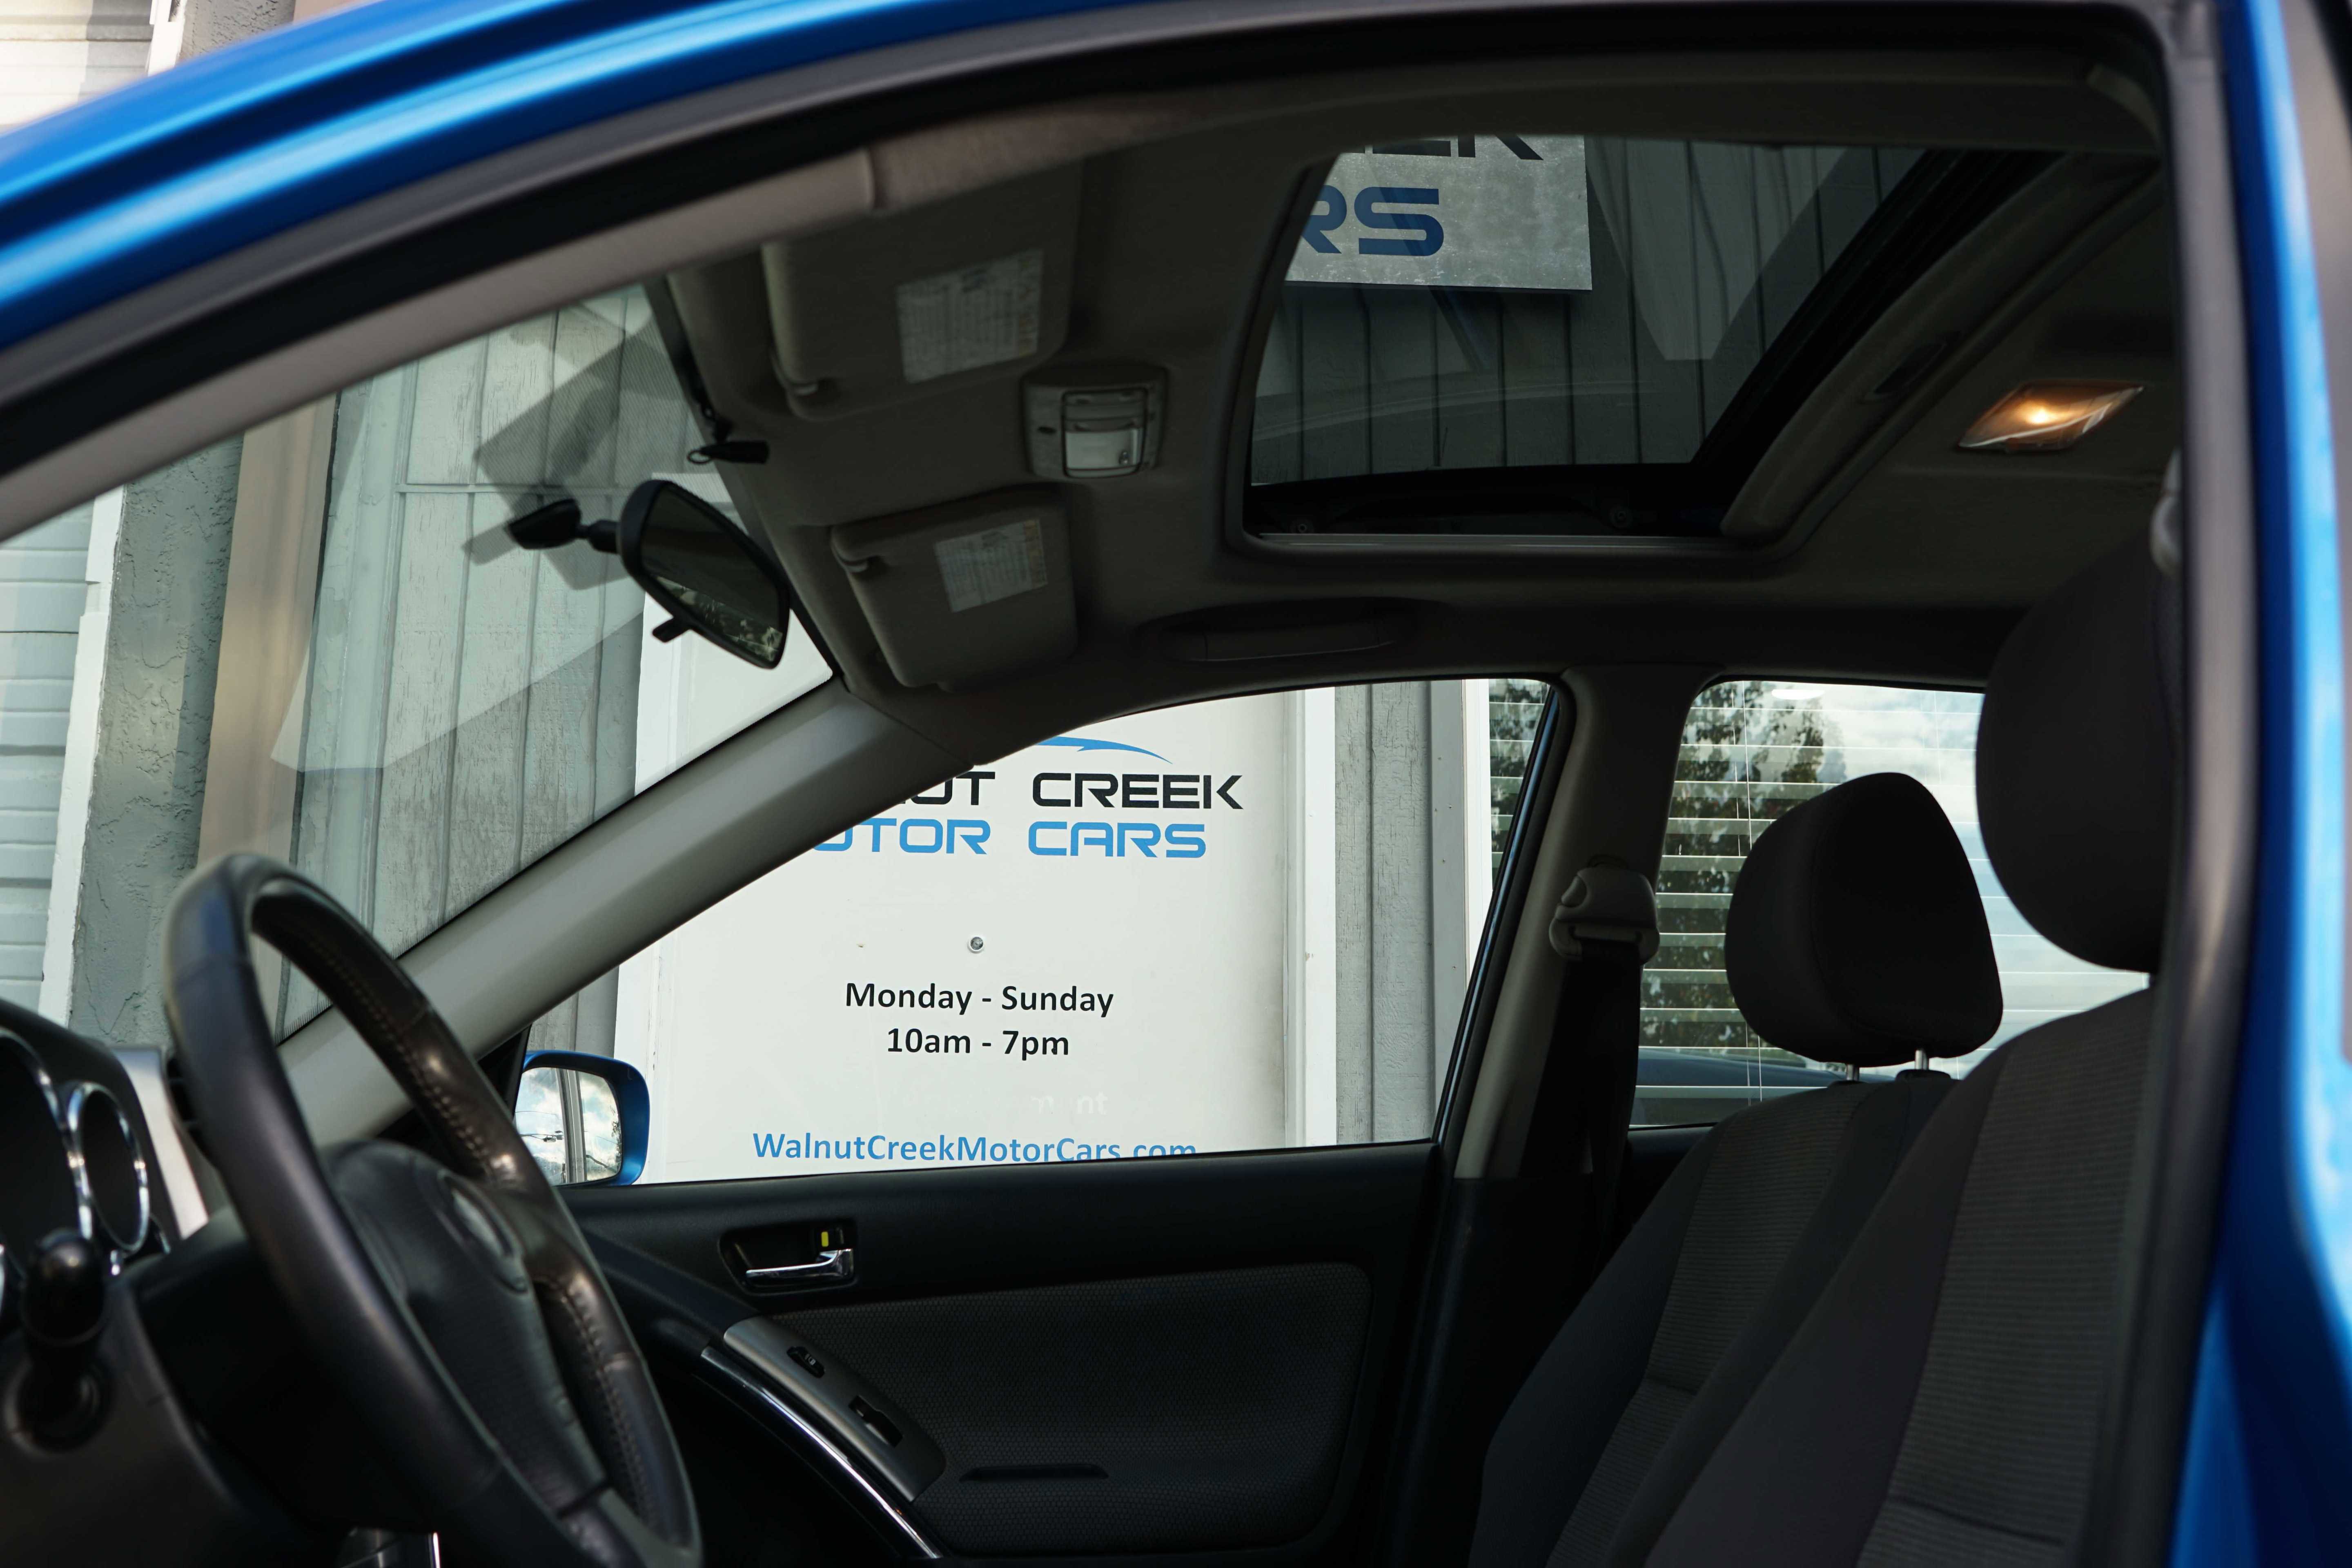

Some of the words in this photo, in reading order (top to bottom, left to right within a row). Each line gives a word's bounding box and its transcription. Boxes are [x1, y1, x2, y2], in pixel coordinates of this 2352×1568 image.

[900, 771, 996, 806] UT
[1032, 773, 1244, 810] CREEK
[1028, 821, 1206, 858] CARS
[846, 982, 972, 1016] Monday
[1002, 985, 1114, 1018] Sunday
[888, 1028, 970, 1054] 10am
[1002, 1030, 1069, 1061] 7pm
[753, 1132, 1196, 1161] WalnutCreekMotorCarscom
